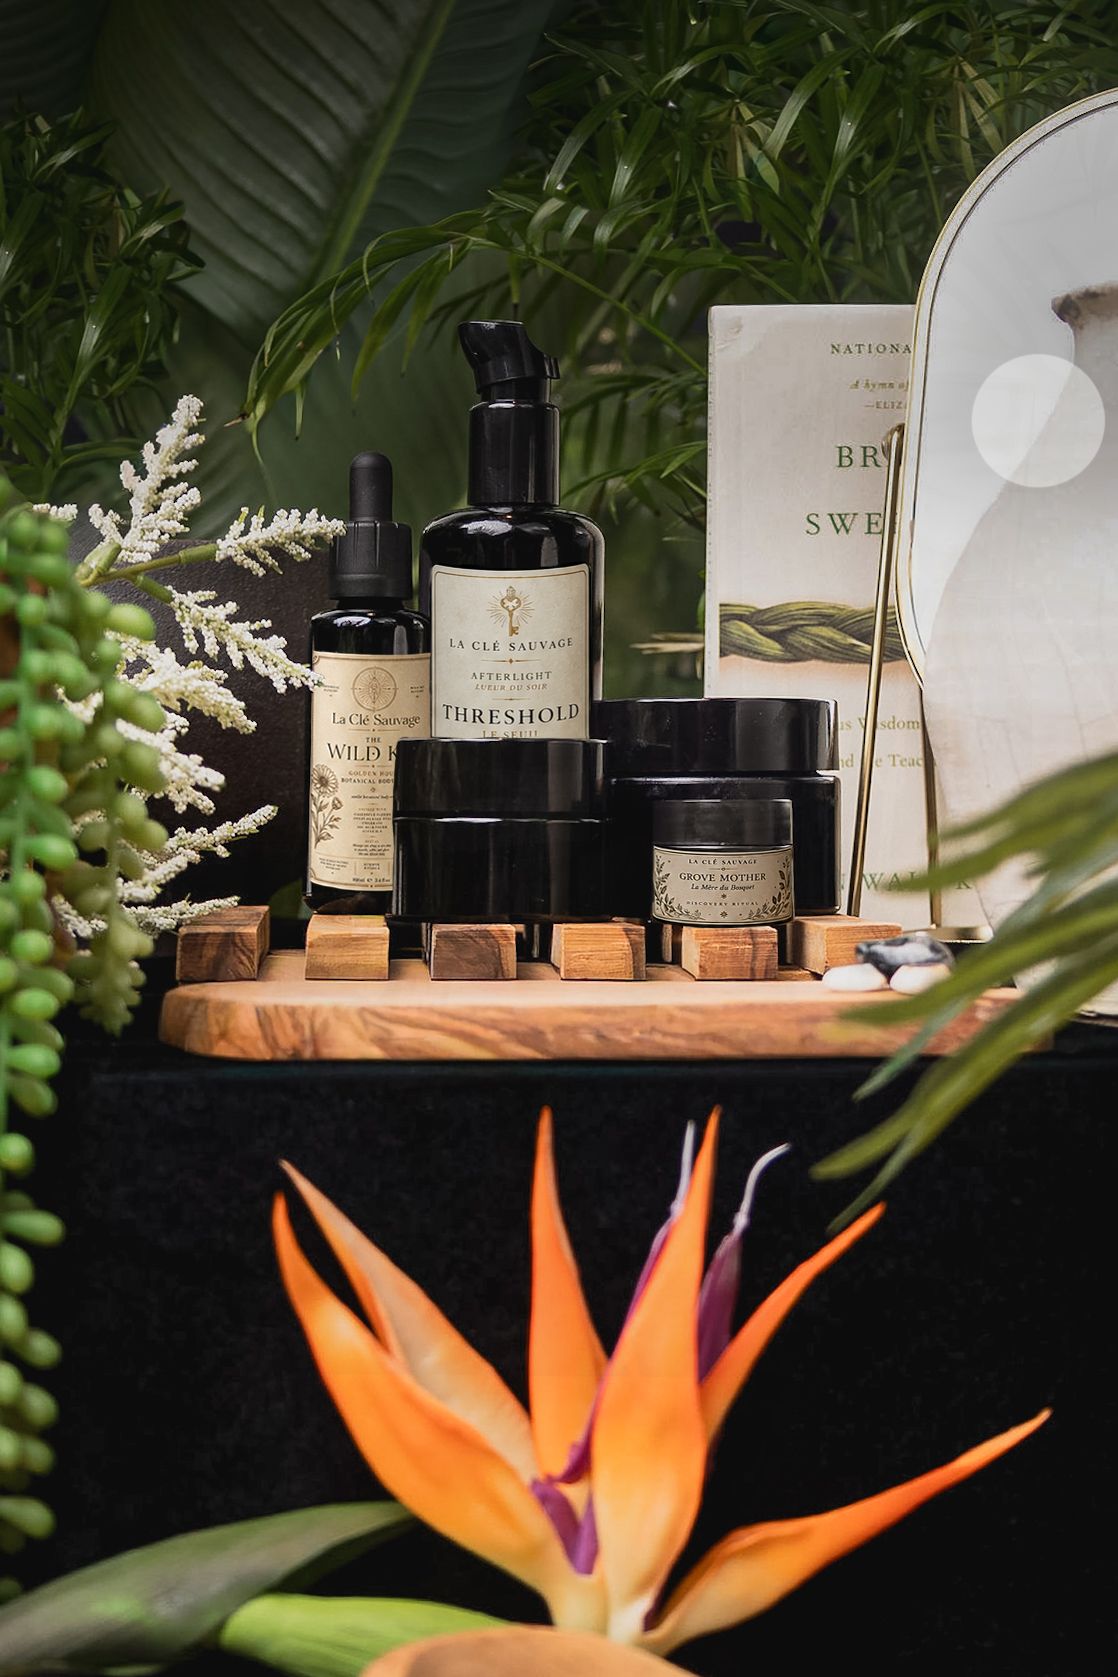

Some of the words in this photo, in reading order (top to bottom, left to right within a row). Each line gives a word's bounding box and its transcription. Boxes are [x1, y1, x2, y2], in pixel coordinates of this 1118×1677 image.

[830, 343, 912, 355] NATIONA
[864, 400, 907, 409] —ELIZ
[836, 445, 882, 468] BR
[805, 512, 882, 535] SWE
[449, 638, 465, 649] LA
[471, 640, 500, 652] CLÉ
[508, 637, 573, 652] SAUVAGE
[471, 671, 552, 681] AFTERLIGHT
[475, 683, 506, 691] LUEUR
[526, 683, 548, 691] SOIR
[332, 712, 346, 725] La
[348, 713, 370, 726] Clé
[373, 714, 421, 728] Sauvage
[442, 703, 579, 725] THRESHOLD
[858, 715, 920, 730] sdom
[327, 743, 381, 762] WILD
[388, 745, 398, 761] K
[888, 753, 924, 768] Teac
[341, 777, 376, 785] BOTANICAL
[679, 872, 716, 882] GROVE
[720, 872, 767, 882] MOTHER
[731, 884, 755, 892] Bosquet
